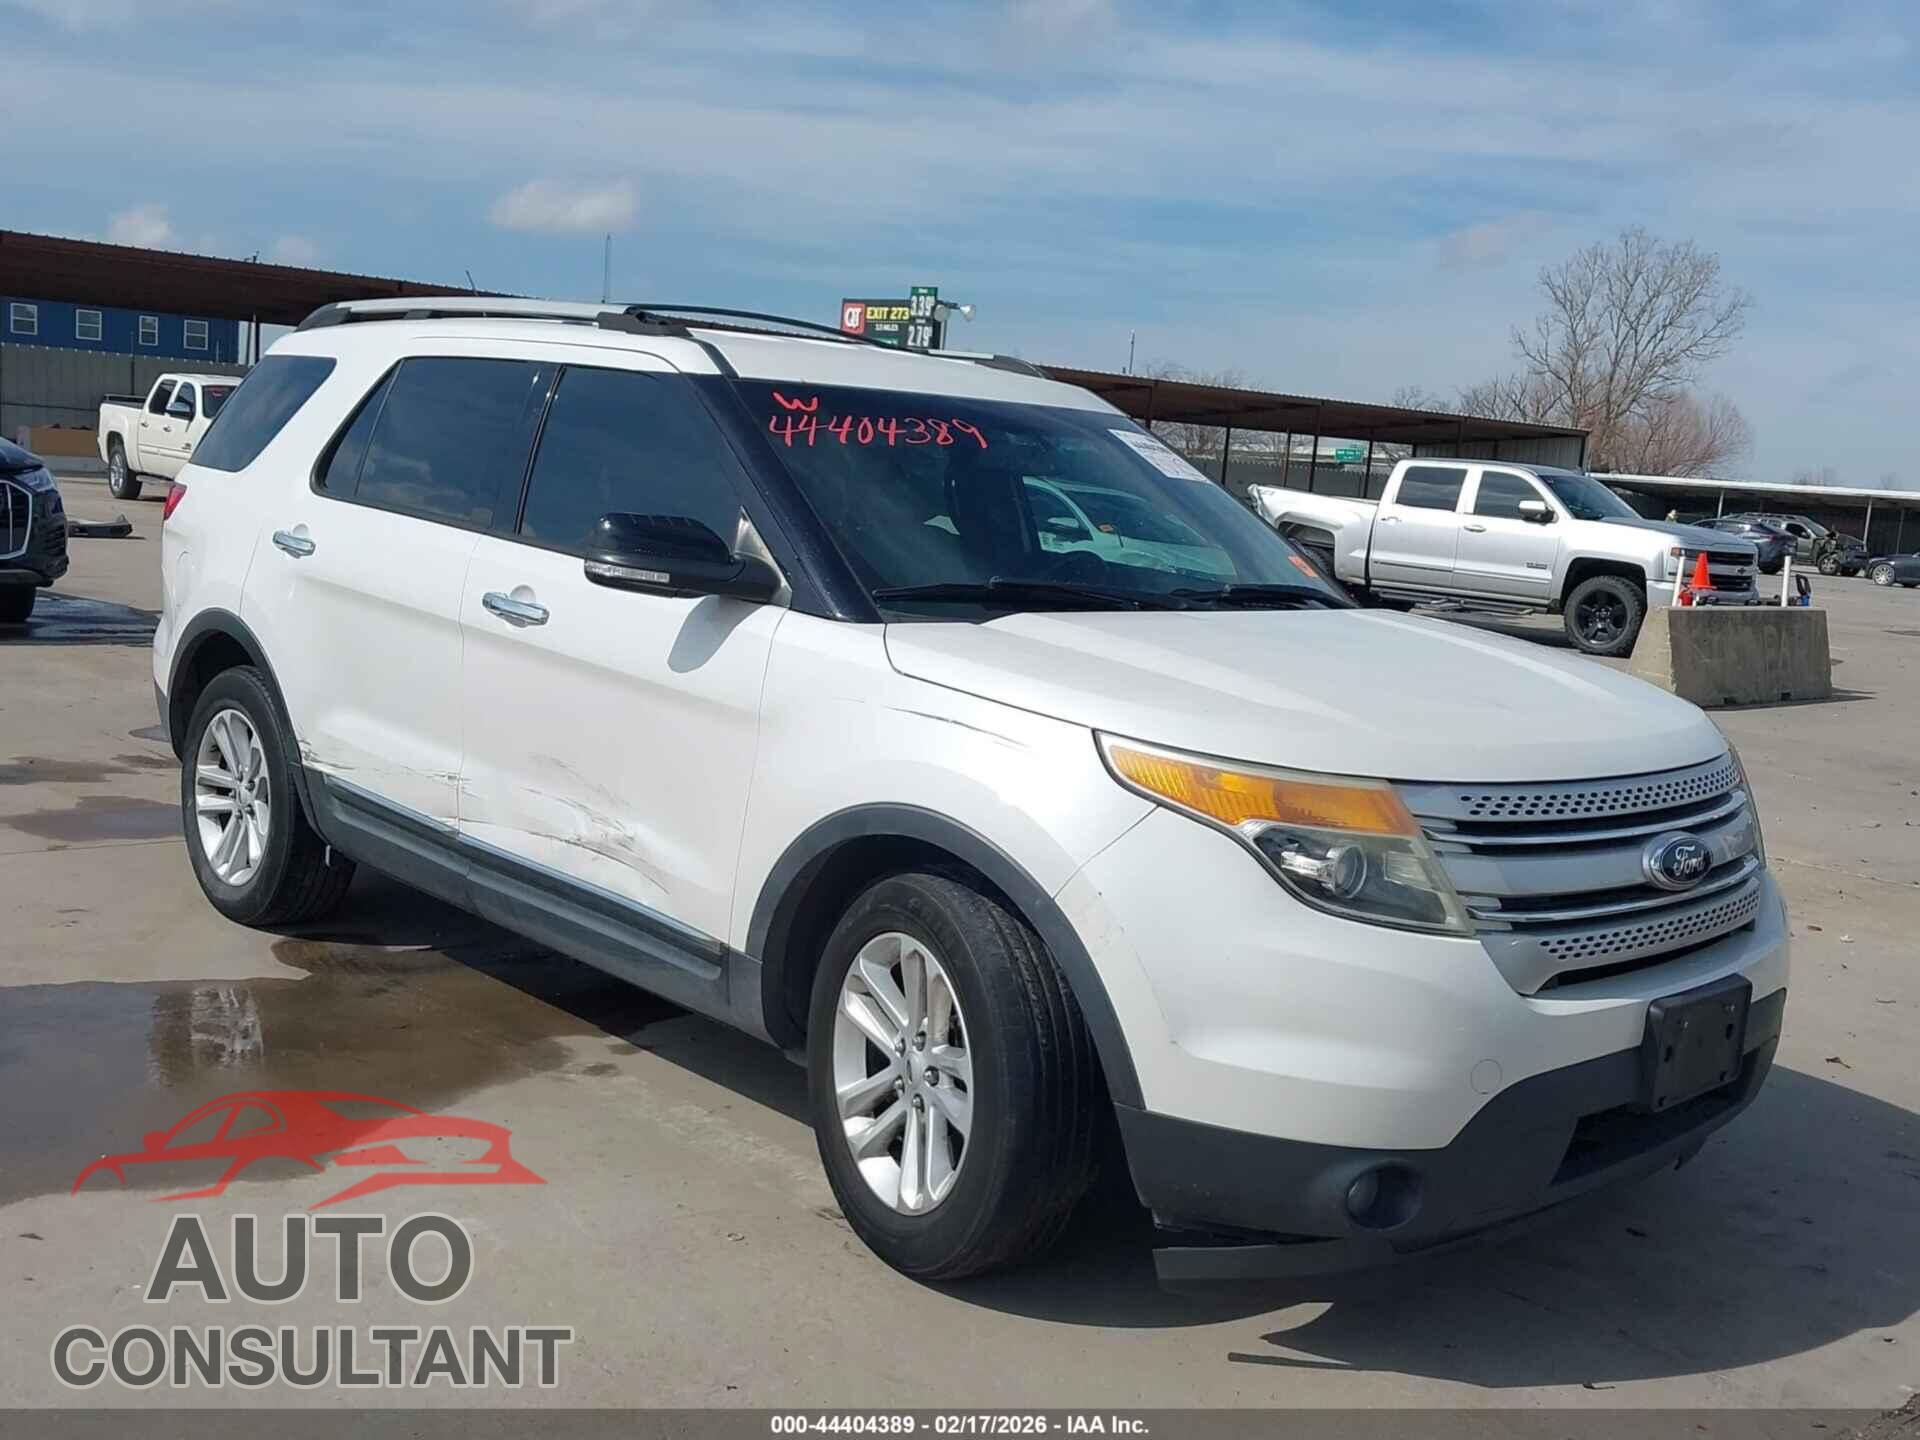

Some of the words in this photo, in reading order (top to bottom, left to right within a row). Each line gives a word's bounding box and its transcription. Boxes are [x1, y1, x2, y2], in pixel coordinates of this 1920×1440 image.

[866, 307, 888, 320] EXIT
[890, 307, 910, 320] 273
[769, 415, 988, 449] 44404389
[1673, 845, 1705, 877] Ford
